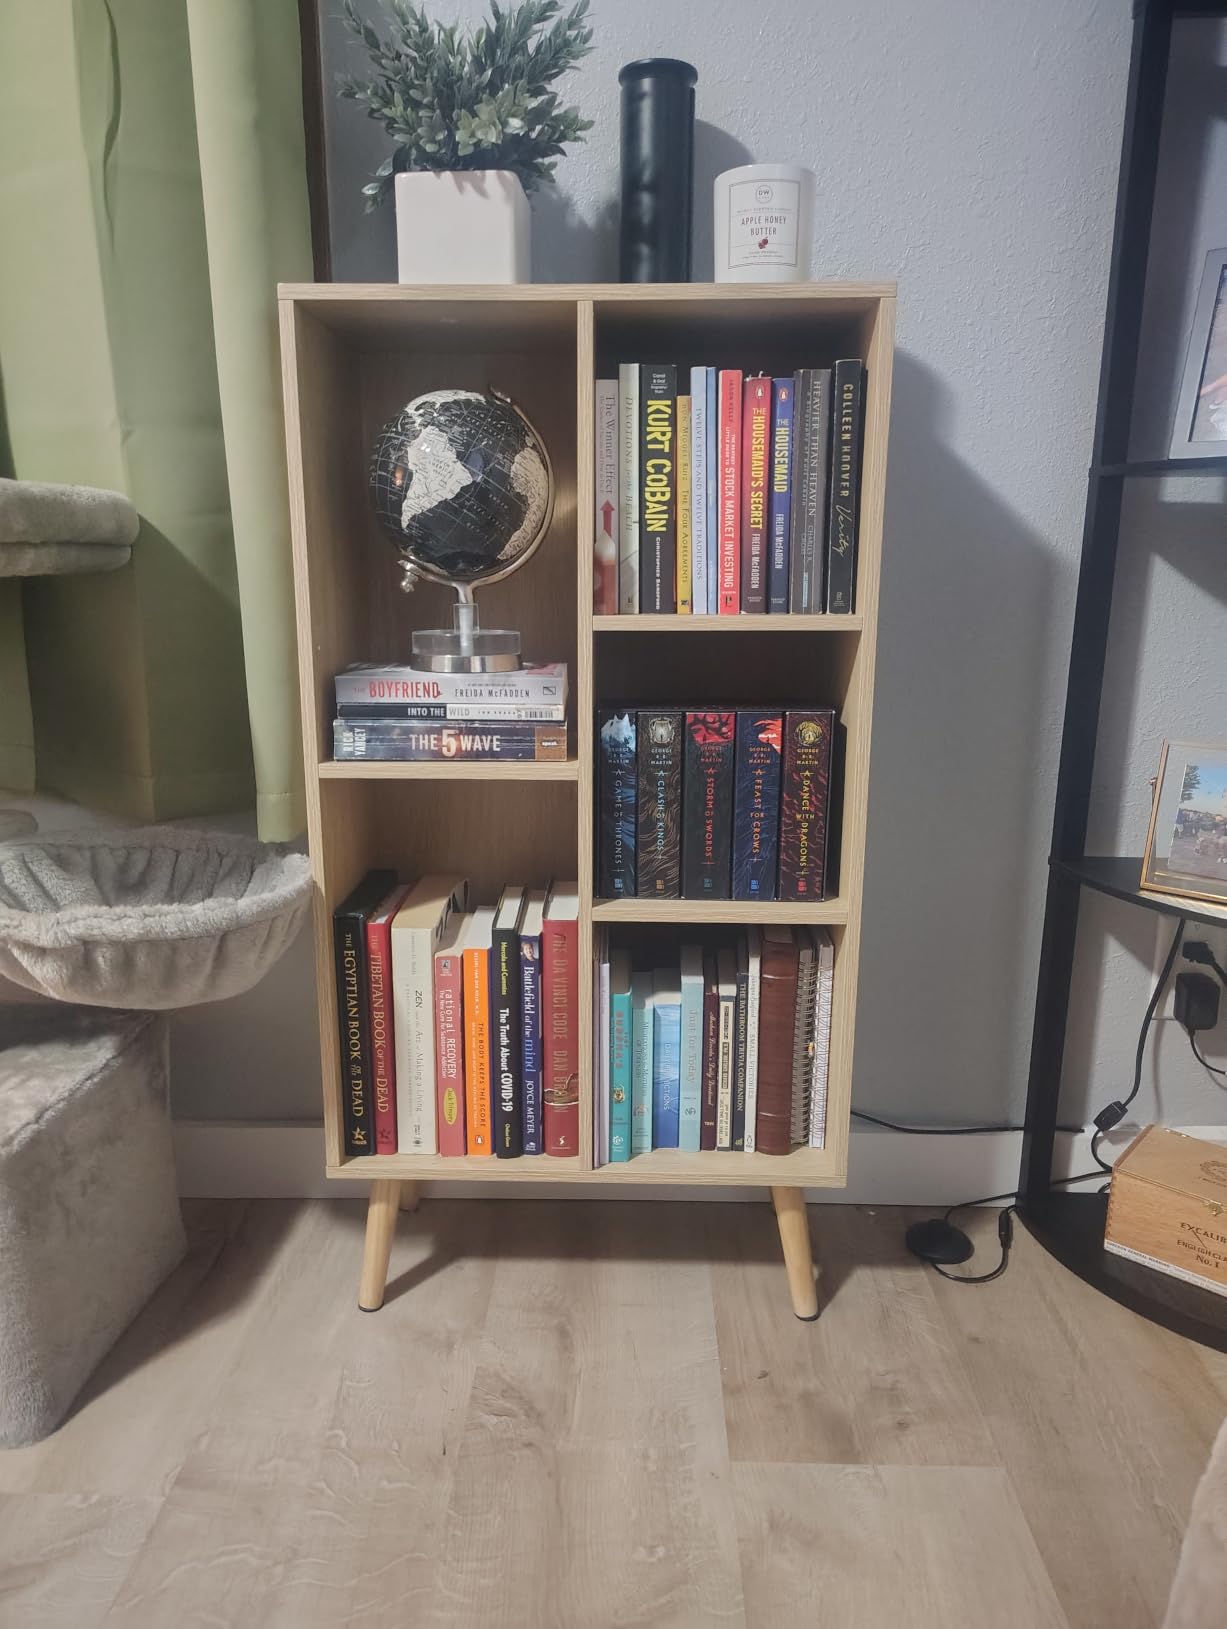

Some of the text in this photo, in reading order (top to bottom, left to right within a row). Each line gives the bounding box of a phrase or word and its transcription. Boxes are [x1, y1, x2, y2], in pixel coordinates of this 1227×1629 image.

[742, 215, 786, 225] APPLE HONEY
[750, 226, 777, 236] BUTTER
[606, 394, 615, 494] The Winner Effect
[646, 400, 672, 452] KURT
[840, 384, 854, 496] COLLEEN HOOVER
[752, 415, 766, 488] HOUSEMAID'S
[774, 428, 790, 492] HOUSEMAID
[808, 380, 821, 516] HEAVIER THAN HEAVEN
[644, 459, 672, 532] COBAIN
[724, 467, 735, 496] STOCK
[724, 500, 735, 538] MARKET
[750, 491, 764, 530] SECRET
[752, 534, 760, 555] FREIDA
[774, 514, 784, 569] FREIDA McFADDEN
[832, 504, 852, 558] Verity
[724, 541, 735, 588] INVESTING
[751, 556, 760, 589] McFADDEN
[369, 682, 442, 698] BOYFRIEND
[455, 688, 530, 698] FREIDA McFADDEN
[408, 708, 428, 716] INTO
[430, 708, 445, 716] THE
[448, 708, 470, 716] WILD
[343, 732, 354, 752] RICK
[354, 728, 366, 756] YANCEY
[408, 734, 438, 750] THE
[460, 735, 501, 752] WAVE
[802, 780, 810, 811] DANCE
[752, 822, 760, 854] CROWS
[800, 822, 808, 867] DRAGONS
[344, 950, 360, 1018] EGYPTIAN
[370, 952, 384, 1008] TIBETAN
[553, 933, 568, 1040] THE DA VINCI CODE
[374, 1012, 386, 1048] BOOK
[445, 990, 456, 1078] rational RECOVERY
[524, 967, 536, 1072] Battlefield of the mind
[348, 1021, 362, 1060] BOOK
[377, 1049, 384, 1058] OF
[687, 1009, 697, 1082] Just Today
[415, 1053, 424, 1080] Making
[500, 1008, 514, 1112] The Truth About COVID-19
[553, 1050, 568, 1070] DAN
[706, 1062, 716, 1077] Daily
[352, 1080, 364, 1117] DEAD
[376, 1078, 389, 1112] DEAD
[416, 1090, 424, 1112] Living
[526, 1080, 536, 1134] JOYCE MEYER
[1177, 1240, 1211, 1256] ENGLISH
[1196, 1255, 1212, 1266] No.
